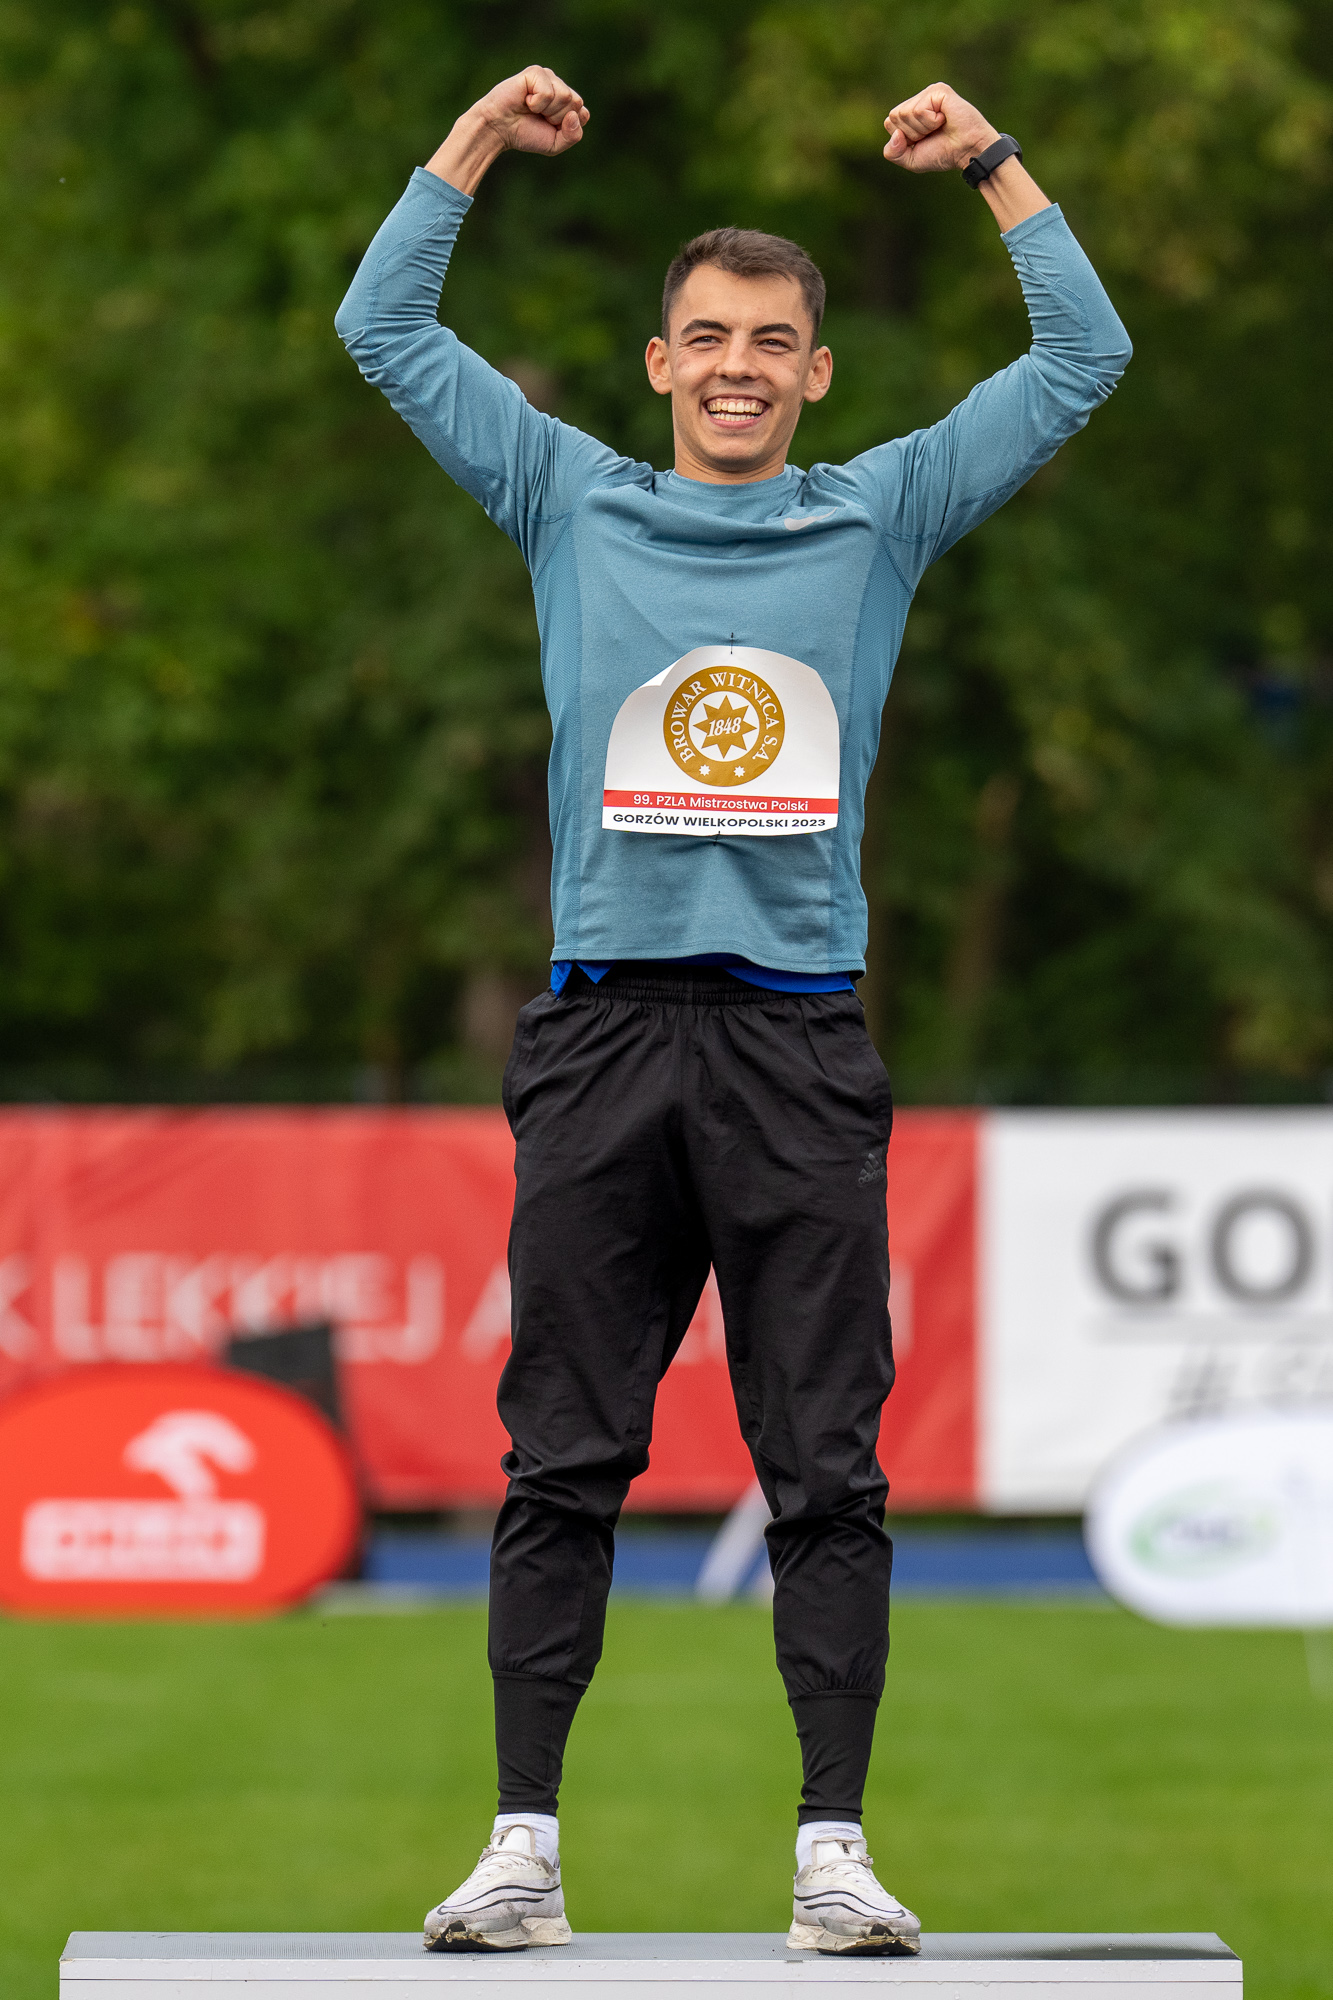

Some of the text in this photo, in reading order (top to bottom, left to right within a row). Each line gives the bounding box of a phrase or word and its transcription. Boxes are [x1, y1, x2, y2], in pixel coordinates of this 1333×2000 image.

[670, 680, 707, 764] BROWAR
[709, 671, 780, 730] WITNICA
[707, 717, 742, 738] 1848
[633, 794, 809, 812] 99. PZLA Mistrzostwa Polski
[613, 812, 826, 828] GORZÓW WIELKOPOLSKI 2023
